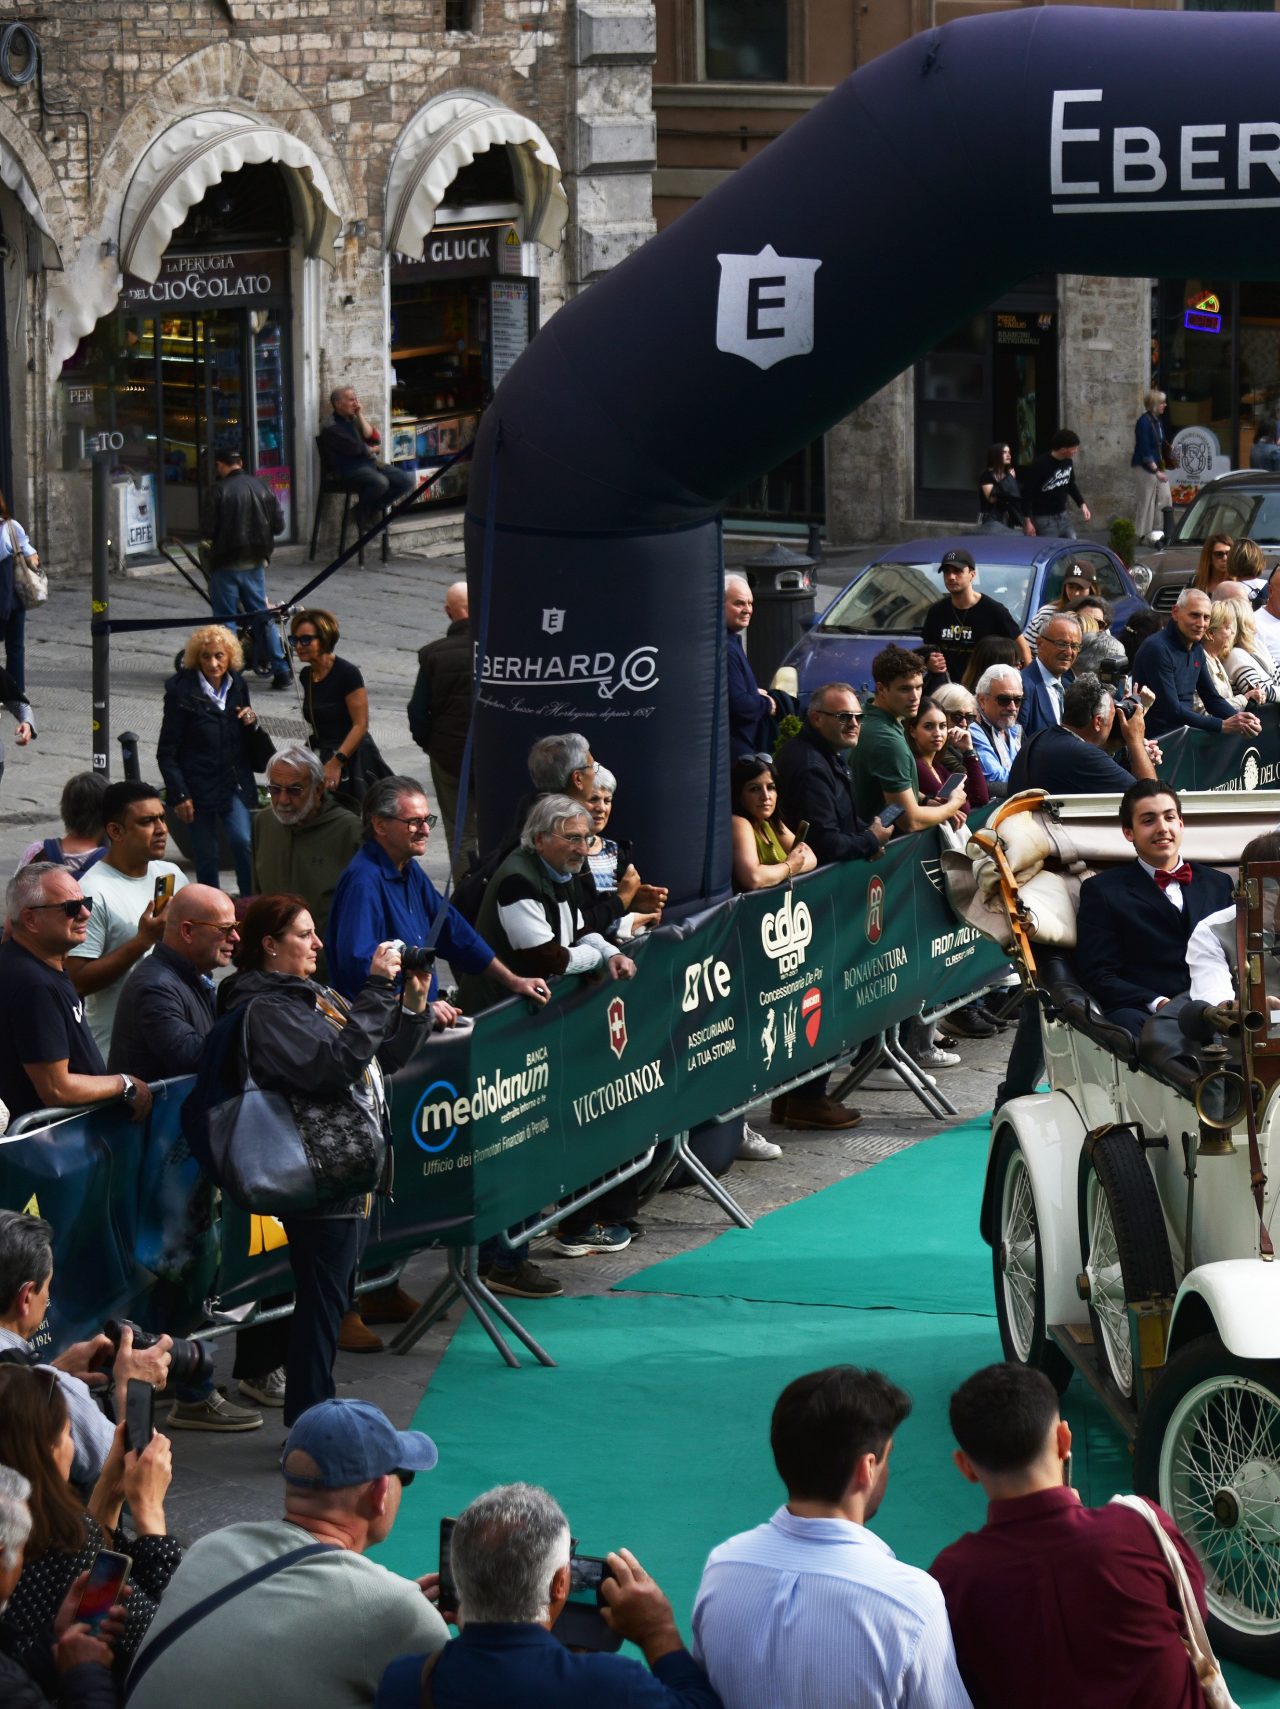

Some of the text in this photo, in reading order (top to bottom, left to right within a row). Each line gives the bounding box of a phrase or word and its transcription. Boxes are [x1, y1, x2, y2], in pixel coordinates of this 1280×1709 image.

[431, 238, 491, 262] GLUCK
[150, 273, 271, 301] CIOCCOLATO
[1260, 764, 1276, 785] DEL
[931, 933, 954, 958] IRON
[779, 952, 798, 974] 100
[843, 945, 908, 990] BONAVENTURA
[760, 965, 824, 1006] Concessionaria De Poi
[856, 973, 898, 1009] MASCHIO
[688, 1017, 735, 1050] ASSICURIAMO
[526, 1046, 548, 1067] BANCA
[687, 1038, 737, 1072] LA TUA STORIA
[422, 1062, 549, 1133] mediolanum
[572, 1059, 665, 1127] VICTORINOX
[423, 1158, 454, 1176] Ufficio
[457, 1152, 472, 1168] dei
[526, 1123, 532, 1139] di
[531, 1116, 550, 1134] Perugia
[36, 1332, 52, 1348] 1924
